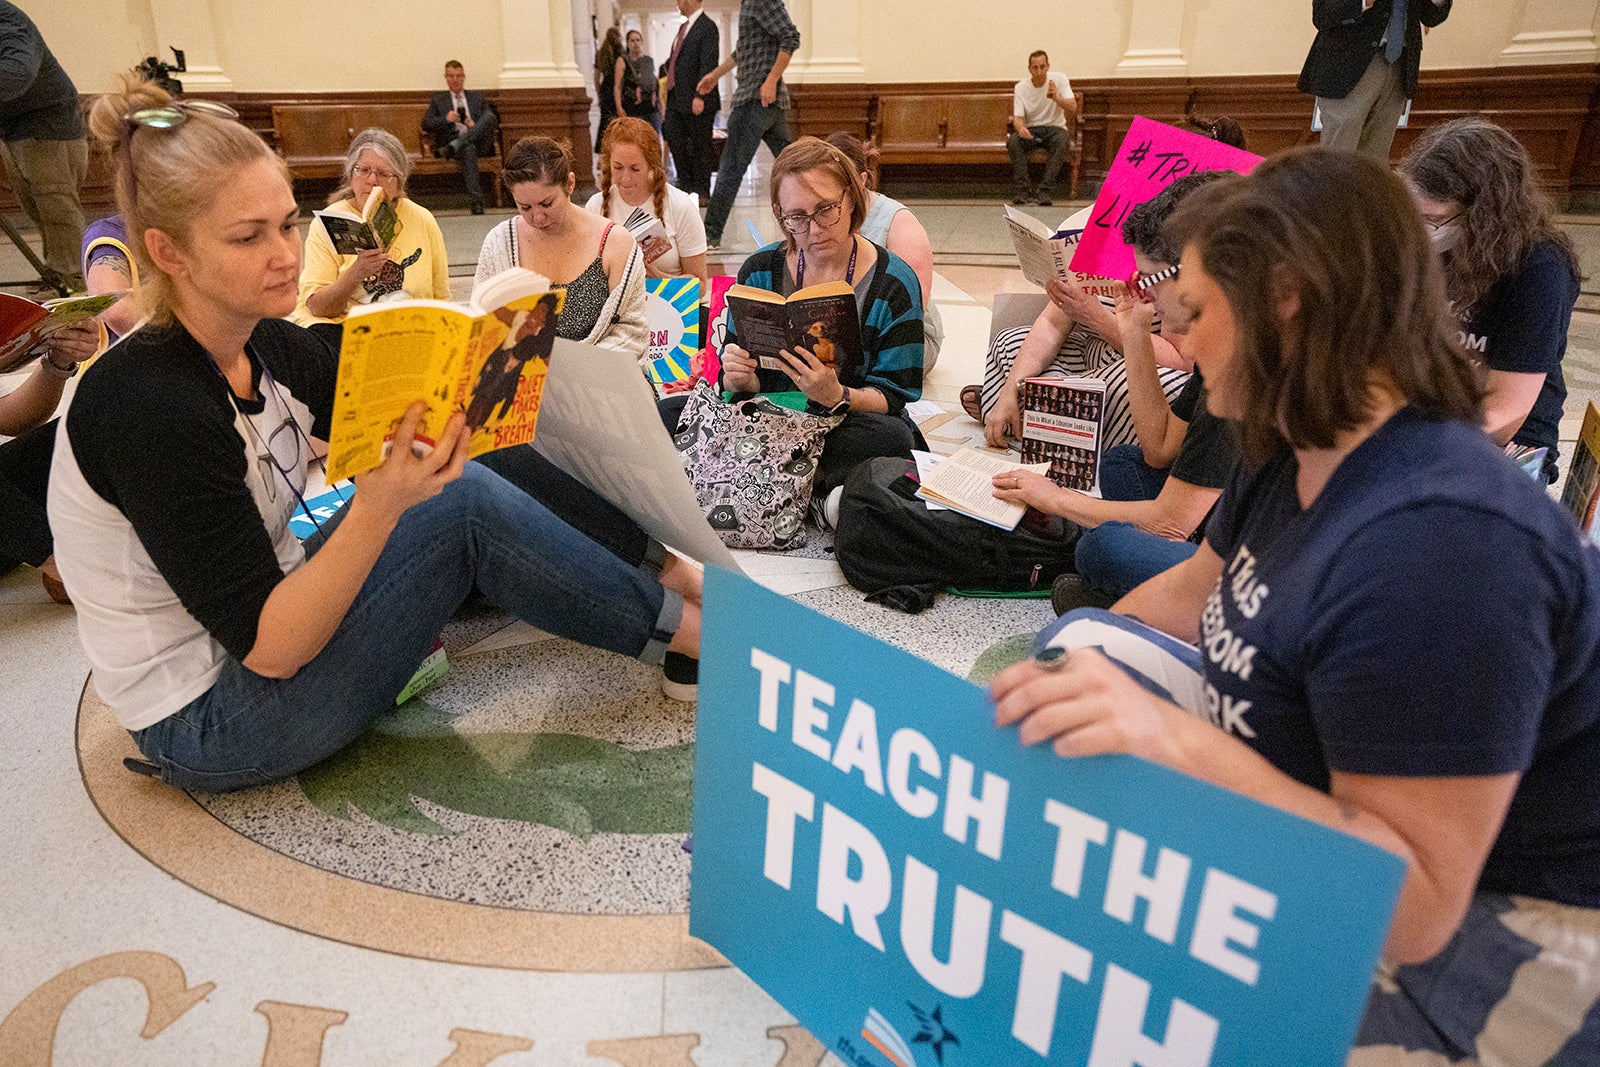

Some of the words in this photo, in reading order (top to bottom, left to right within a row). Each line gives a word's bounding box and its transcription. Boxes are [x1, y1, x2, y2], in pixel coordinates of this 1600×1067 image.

[1127, 140, 1199, 183] #TR
[1064, 234, 1081, 247] AL
[494, 419, 535, 448] BREATH
[751, 646, 1010, 862] TEACH
[1043, 797, 1278, 988] THE
[752, 761, 1220, 1067] TRUTH
